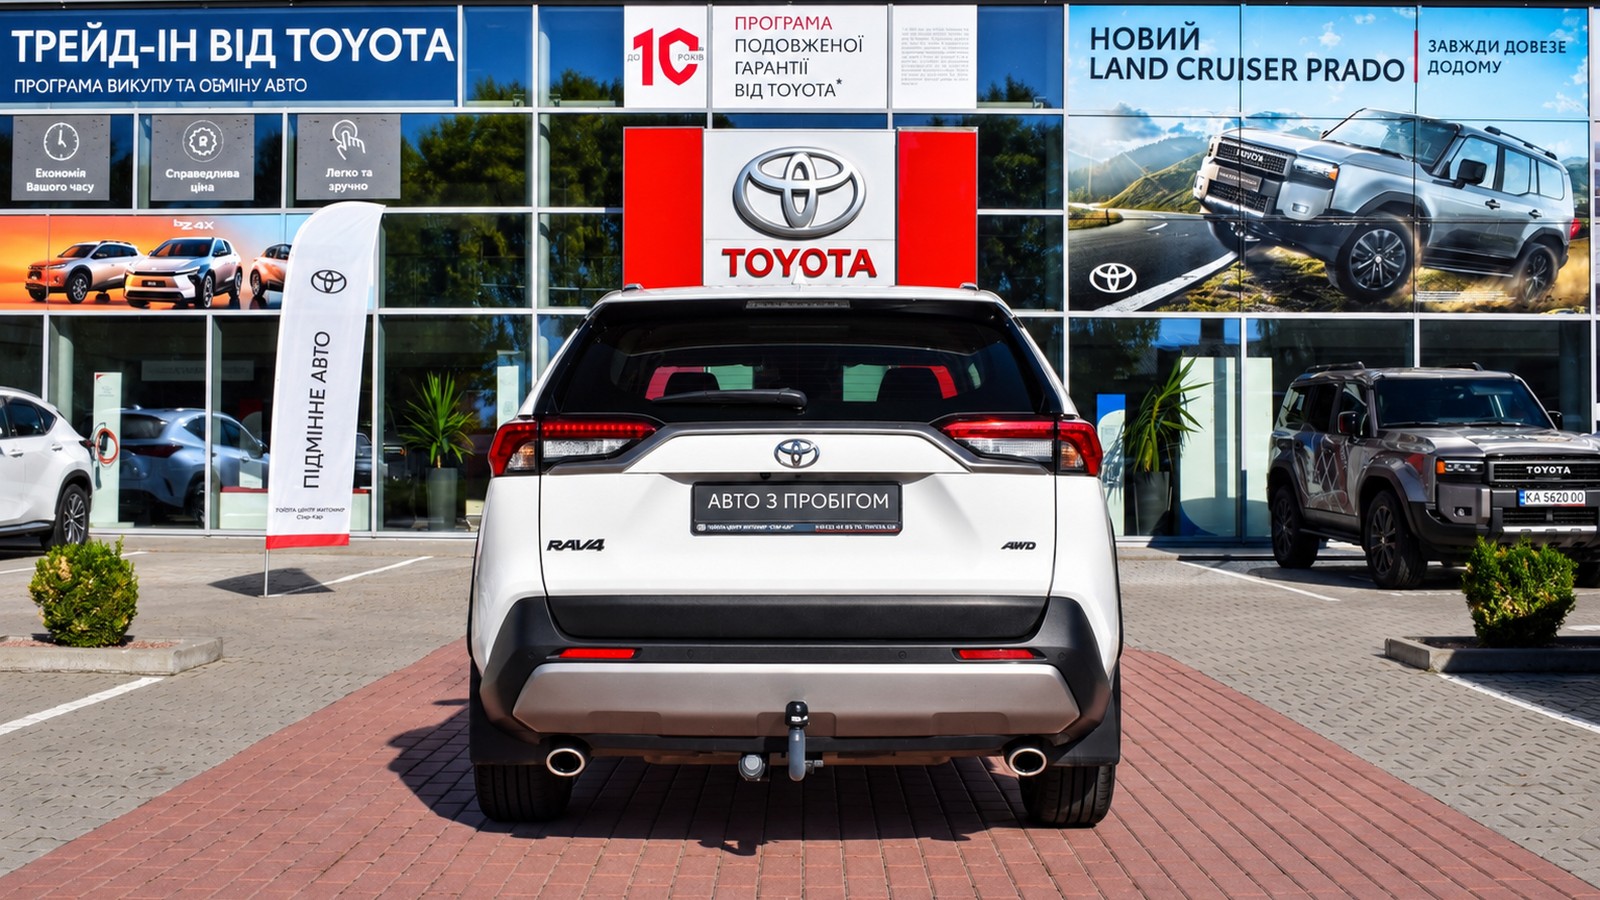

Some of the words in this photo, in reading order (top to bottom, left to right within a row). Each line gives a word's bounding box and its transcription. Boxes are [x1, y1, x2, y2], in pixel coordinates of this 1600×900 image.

[735, 15, 833, 31] ПРОГРАМА
[1091, 21, 1200, 51] НОВИЙ
[11, 22, 197, 68] ТРЕЙД-ІН
[210, 28, 277, 69] ВІД
[286, 27, 455, 62] TOYOTA
[735, 35, 864, 55] ПОДОВЖЕНОЇ
[1428, 39, 1500, 56] ЗАВЖДИ
[1504, 40, 1567, 56] ДОВЕЗЕ
[677, 53, 705, 61] РОКІВ
[735, 58, 810, 75] ГАРАНТІЇ
[1090, 56, 1169, 80] LAND
[1176, 57, 1298, 82] CRUISER
[1306, 58, 1405, 83] PRADO
[1427, 60, 1502, 76] ДОДОМУ
[14, 78, 104, 94] ПРОГРАМА
[107, 78, 173, 93] ВИКУПУ
[175, 78, 196, 93] ТА
[199, 78, 262, 93] ОБМІНУ
[264, 78, 308, 93] АВТО
[735, 83, 764, 100] ВІД
[35, 168, 87, 178] Економія
[165, 168, 240, 181] Справедлива
[325, 167, 359, 178] Легко
[361, 169, 373, 178] та
[26, 182, 68, 192] Вашого
[69, 183, 95, 194] часу
[190, 182, 215, 194] ціна
[328, 183, 369, 193] зручно
[721, 247, 878, 278] TOYOTA
[311, 331, 331, 383] АВТО
[303, 388, 326, 488] ПІДМІННЕ
[1526, 466, 1571, 474] TOYOTA
[707, 493, 760, 509] АВТО
[766, 493, 778, 509] З
[784, 493, 889, 509] ПРОБІГОМ
[546, 538, 606, 552] RAV4
[1000, 541, 1037, 551] AWD
